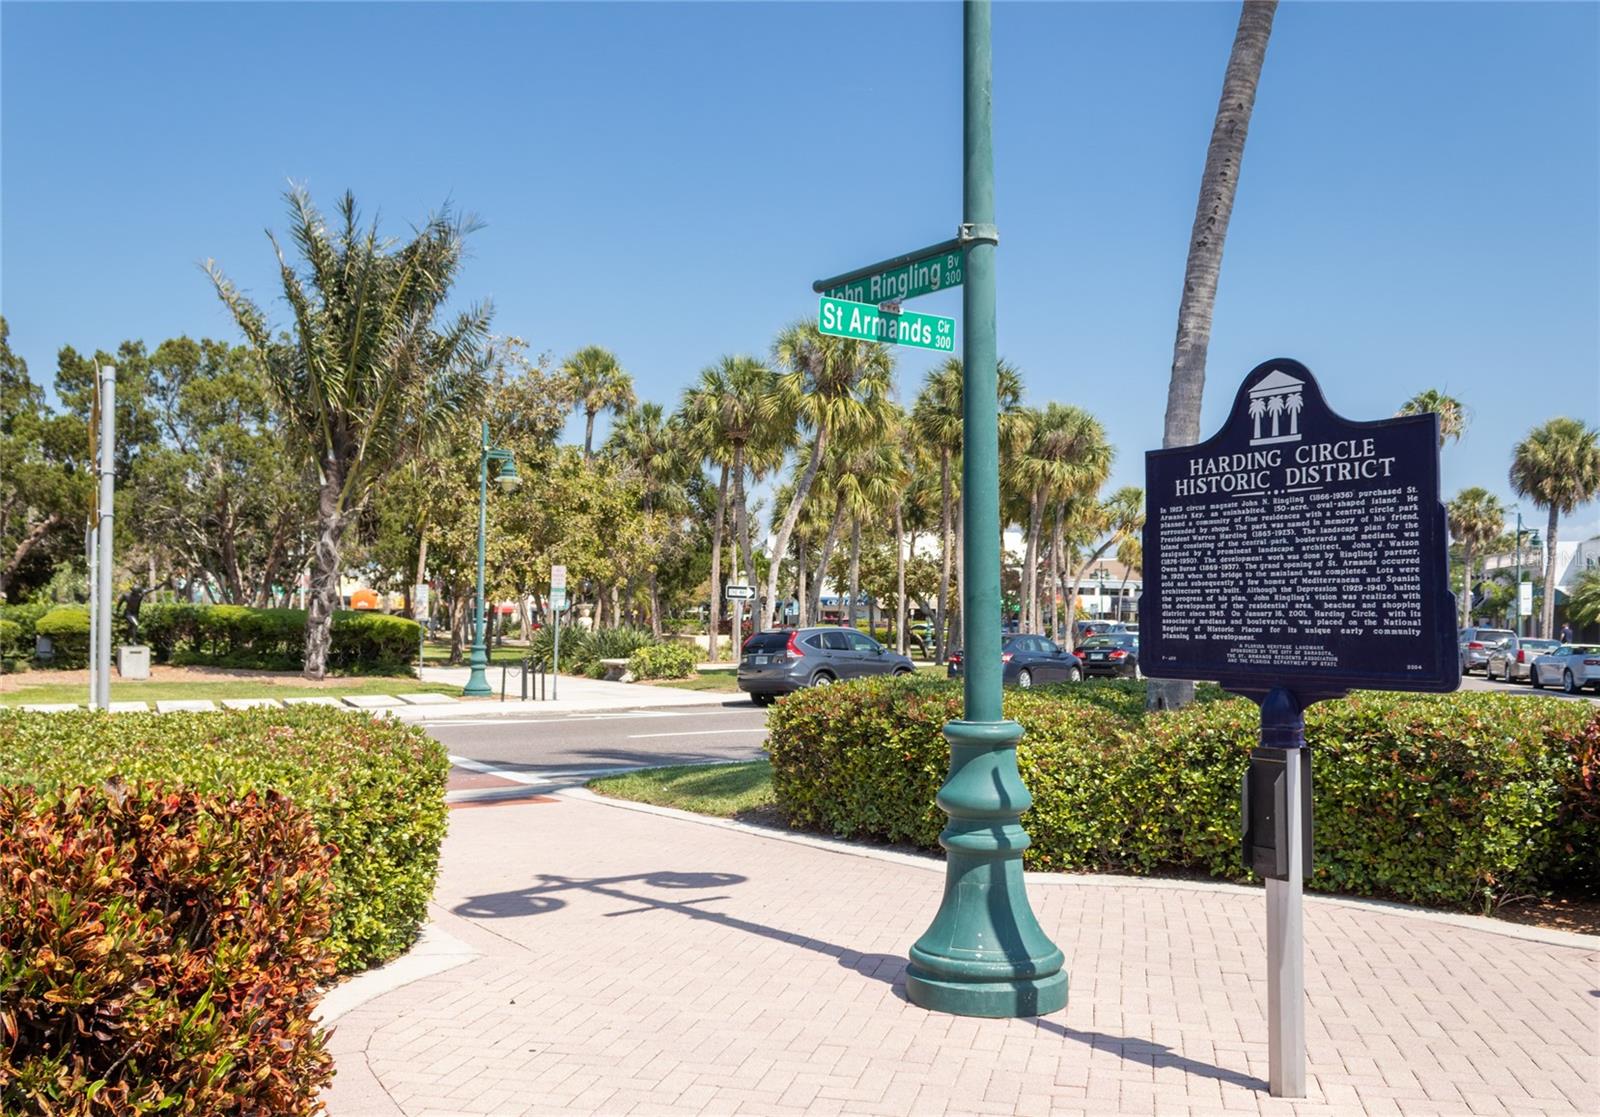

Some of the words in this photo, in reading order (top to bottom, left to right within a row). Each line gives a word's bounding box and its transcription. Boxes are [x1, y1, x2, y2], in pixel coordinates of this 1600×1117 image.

[870, 261, 941, 299] Ringling
[948, 256, 960, 268] Bv
[945, 269, 961, 286] 300
[823, 302, 843, 330] St
[850, 307, 931, 344] Armands
[938, 320, 950, 334] Cir
[935, 335, 951, 349] 300
[1190, 450, 1281, 476] HARDING
[1295, 438, 1376, 464] CIRCLE
[1175, 470, 1270, 497] HISTORIC
[1285, 457, 1396, 486] DISTRICT
[1210, 501, 1238, 511] magnate
[1273, 495, 1304, 506] Ringling
[1358, 487, 1402, 499] purchased
[1160, 512, 1188, 521] Armands
[1316, 499, 1366, 511] oval-shaped
[1406, 495, 1419, 503] He
[1160, 520, 1185, 529] planned
[1196, 517, 1230, 527] community
[1262, 512, 1300, 521] residences
[1335, 507, 1365, 516] central
[1369, 505, 1394, 514] circle
[1398, 504, 1419, 514] park
[1160, 527, 1195, 535] surrounded
[1199, 526, 1208, 534] by
[1251, 522, 1267, 531] park
[1287, 520, 1310, 528] named
[1324, 518, 1355, 527] memory
[1219, 532, 1247, 541] Harding
[1320, 525, 1359, 535] landscape
[1364, 523, 1382, 533] plan
[1404, 521, 1419, 529] the
[1160, 550, 1190, 559] designed
[1216, 547, 1252, 556] prominent
[1258, 545, 1294, 554] landscape
[1388, 539, 1420, 547] Watson
[1183, 541, 1214, 550] consisting
[1295, 534, 1337, 543] boulevards
[1219, 554, 1263, 564] development
[1324, 551, 1334, 560] by
[1259, 562, 1280, 570] grand
[1283, 560, 1312, 570] opening
[1342, 558, 1377, 566] Armands
[1381, 556, 1420, 565] occurred
[1190, 579, 1235, 588] subsequently
[1301, 576, 1360, 584] Mediterranean
[1386, 574, 1421, 584] Spanish
[1221, 571, 1242, 579] bridge
[1246, 586, 1277, 594] Although
[1296, 585, 1338, 594] Depression
[1382, 601, 1421, 610] shopping
[1314, 610, 1345, 618] Harding
[1316, 618, 1343, 627] placed
[1304, 626, 1331, 635] unique
[1340, 627, 1364, 635] early
[1373, 627, 1421, 636] community
